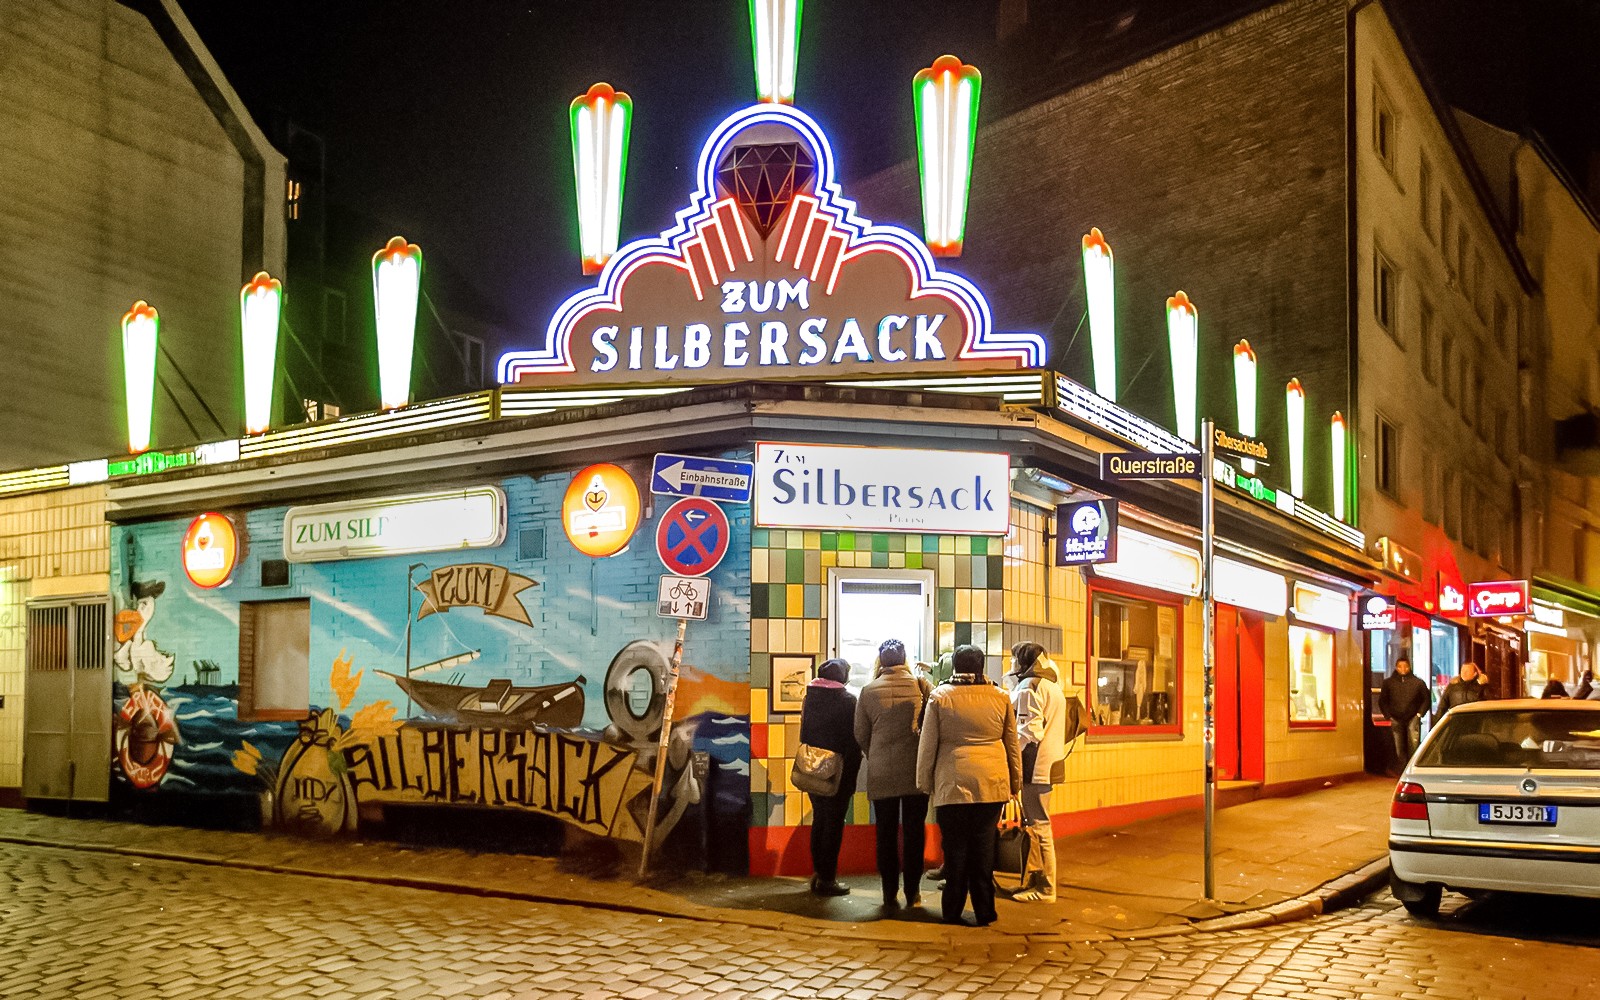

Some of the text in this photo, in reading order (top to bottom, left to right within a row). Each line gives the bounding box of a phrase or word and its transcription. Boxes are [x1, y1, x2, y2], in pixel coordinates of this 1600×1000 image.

[720, 277, 810, 313] ZUM
[590, 314, 948, 373] SILBERSACK
[680, 471, 746, 487] Einbahnstraße
[1110, 456, 1196, 475] Querstraße
[296, 521, 341, 544] ZUM
[436, 567, 493, 606] ZUM
[344, 728, 632, 831] SILBERSACK
